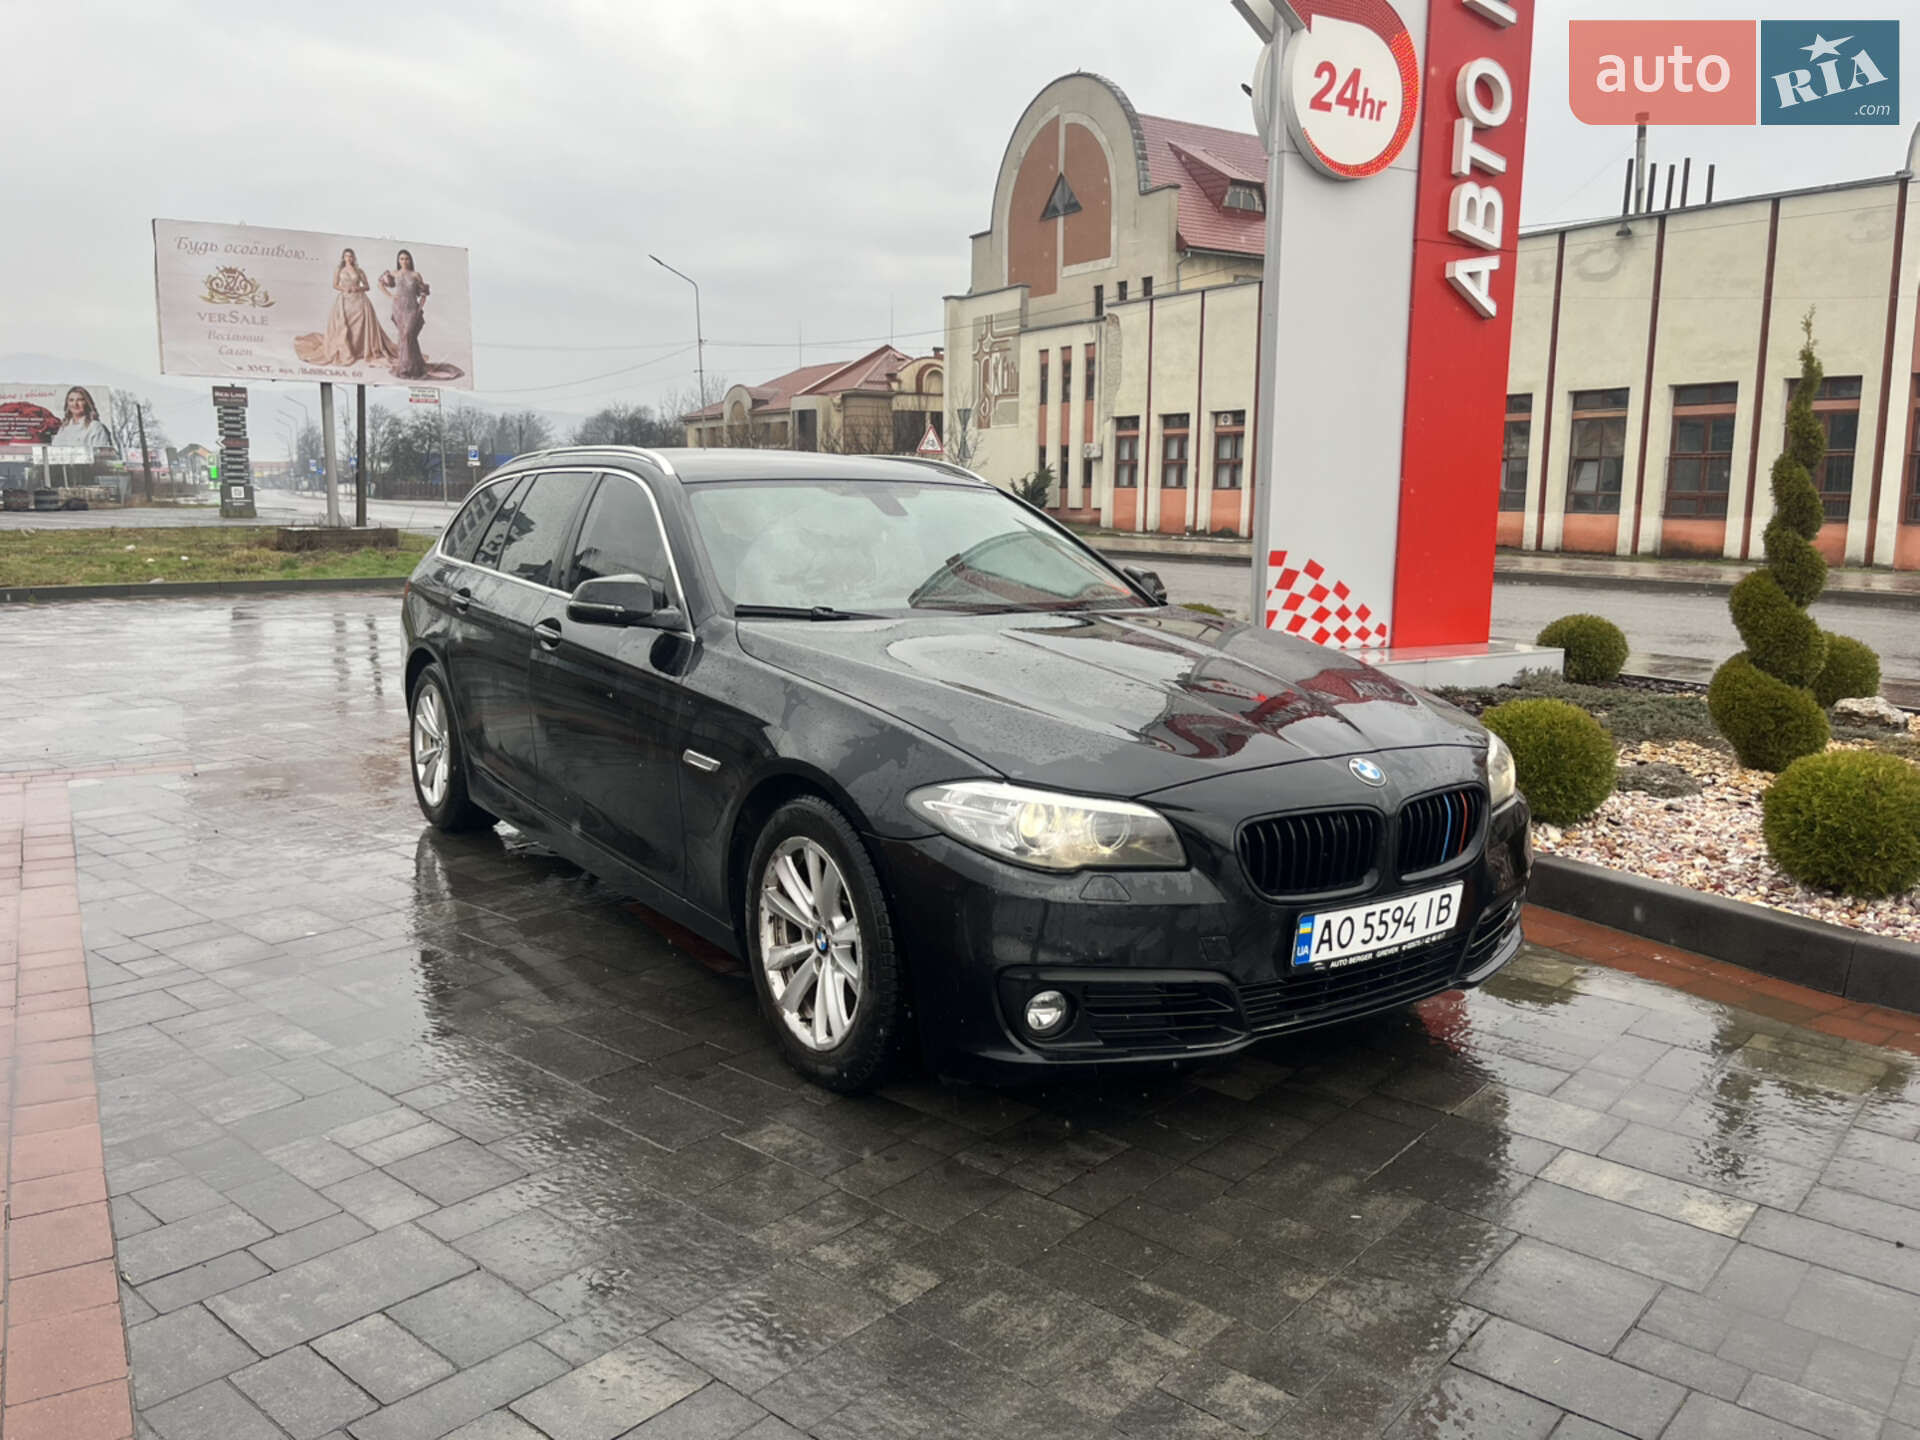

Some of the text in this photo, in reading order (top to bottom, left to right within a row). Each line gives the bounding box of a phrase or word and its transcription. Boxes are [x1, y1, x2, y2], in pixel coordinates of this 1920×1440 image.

[1309, 60, 1388, 122] 24hr
[1445, 57, 1513, 320] АВТО
[174, 236, 219, 257] Будь
[1315, 916, 1354, 954] AO
[1361, 902, 1417, 945] 5594
[1425, 893, 1453, 929] IB
[1296, 944, 1309, 956] UA
[1330, 958, 1347, 968] AUTO
[1349, 952, 1373, 965] BERGER
